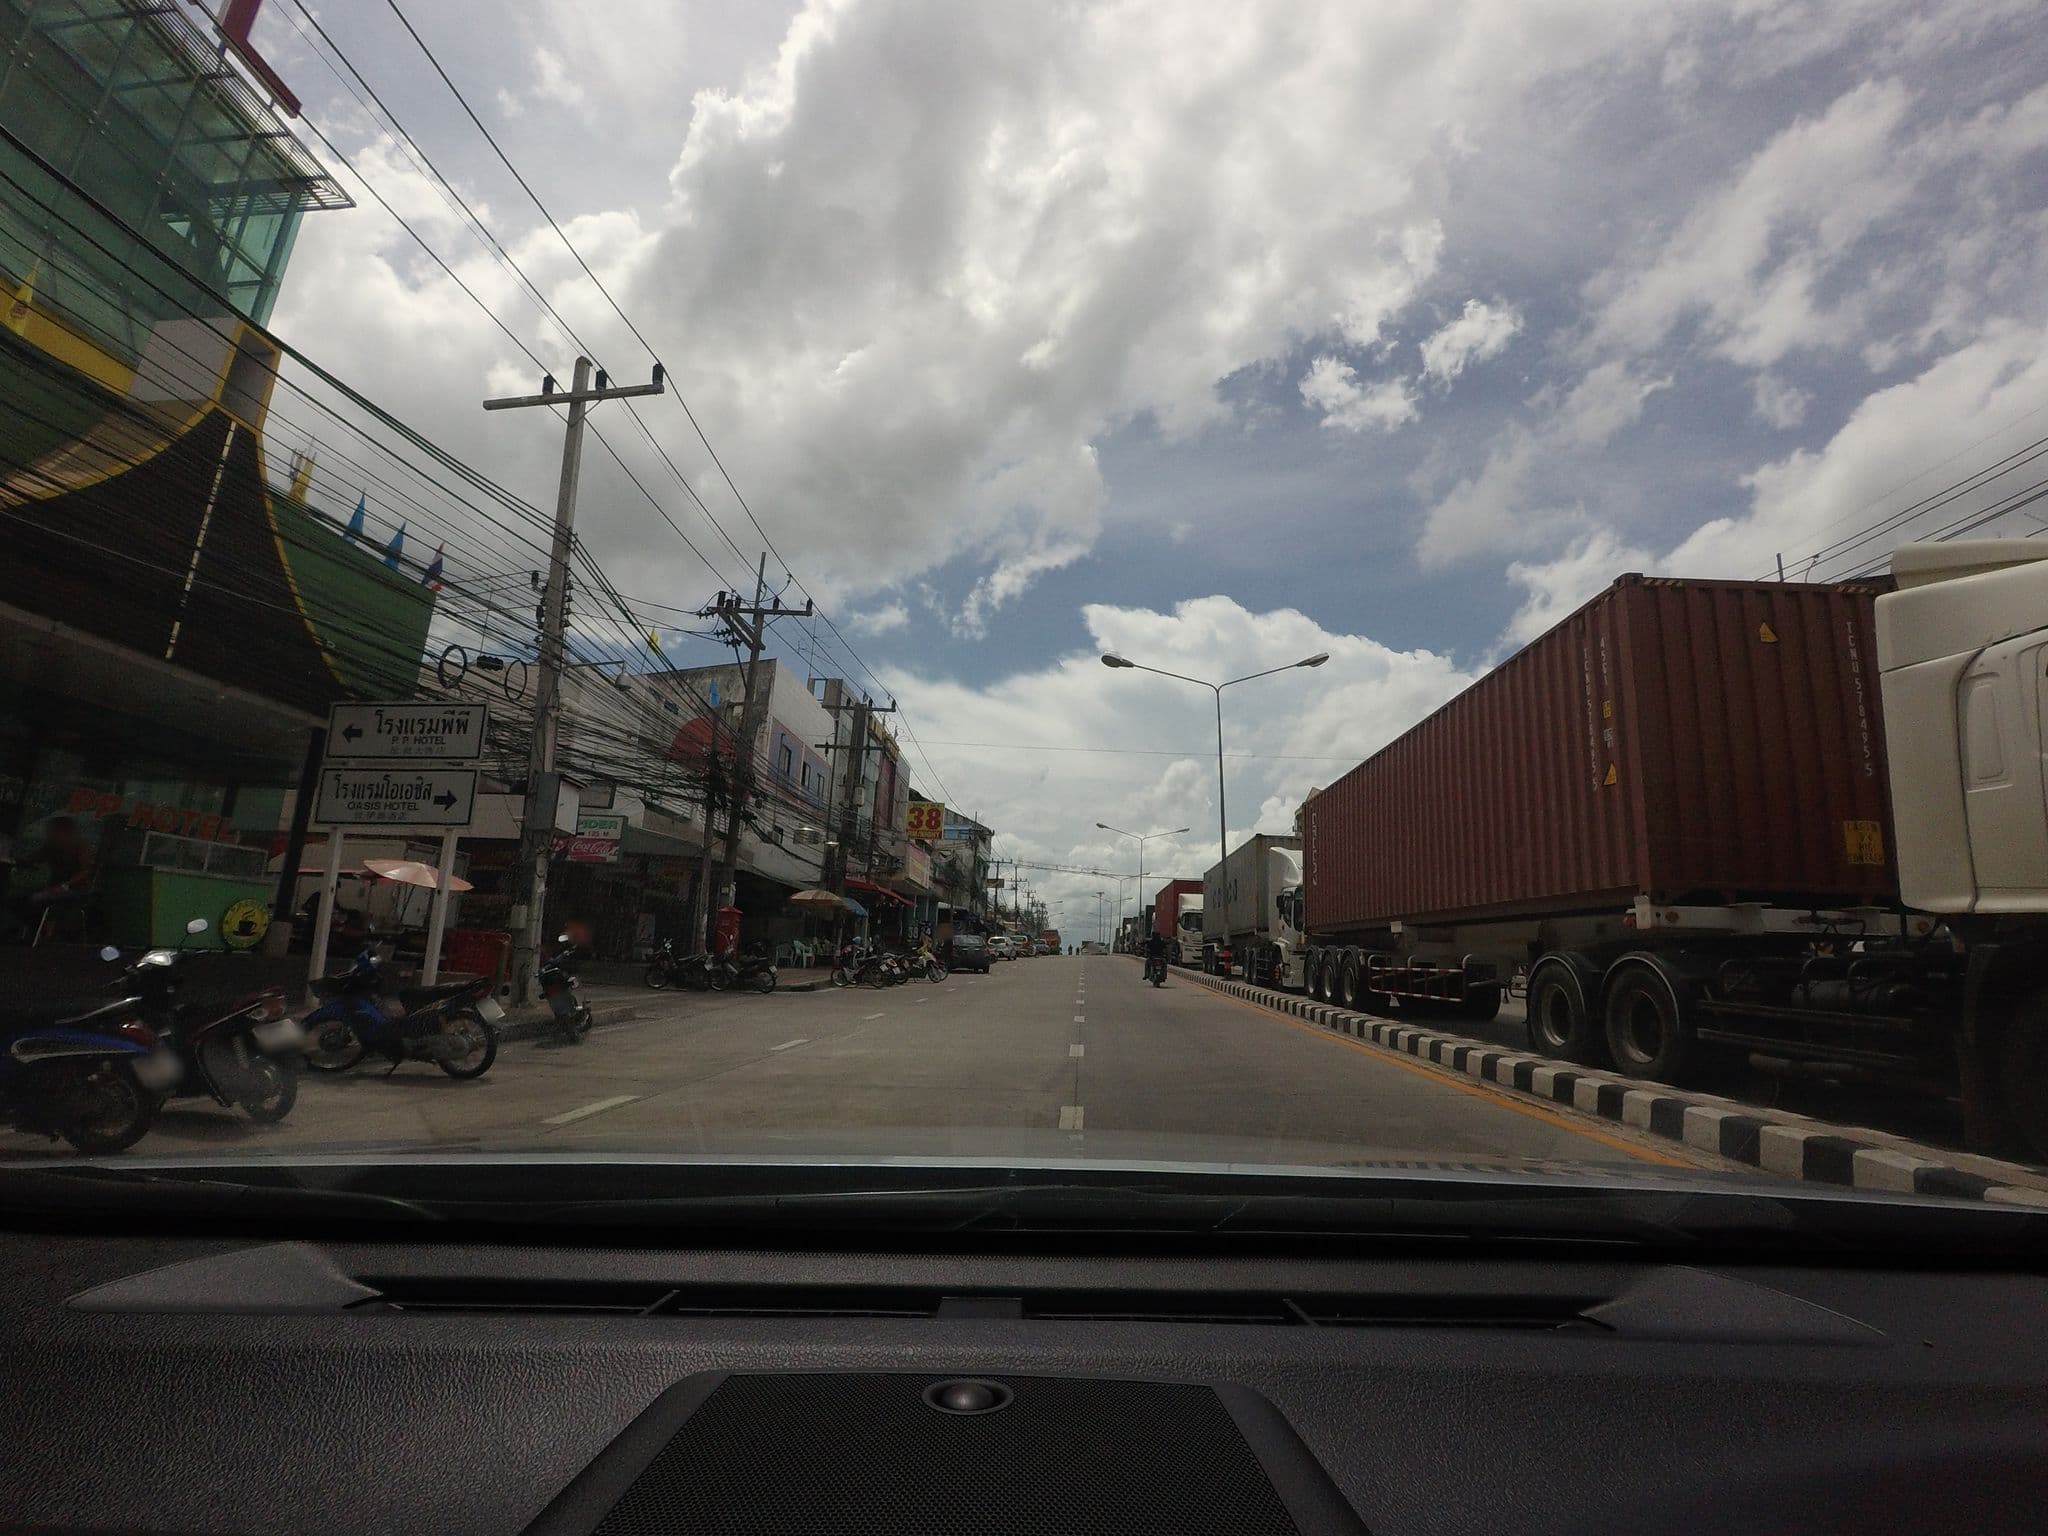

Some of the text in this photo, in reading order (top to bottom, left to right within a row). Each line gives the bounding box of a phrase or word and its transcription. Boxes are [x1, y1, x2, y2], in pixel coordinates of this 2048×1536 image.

[414, 736, 446, 745] HOTEL
[347, 801, 419, 811] OASIS HOTEL
[130, 802, 234, 843] HOTEL
[908, 807, 941, 829] 38
